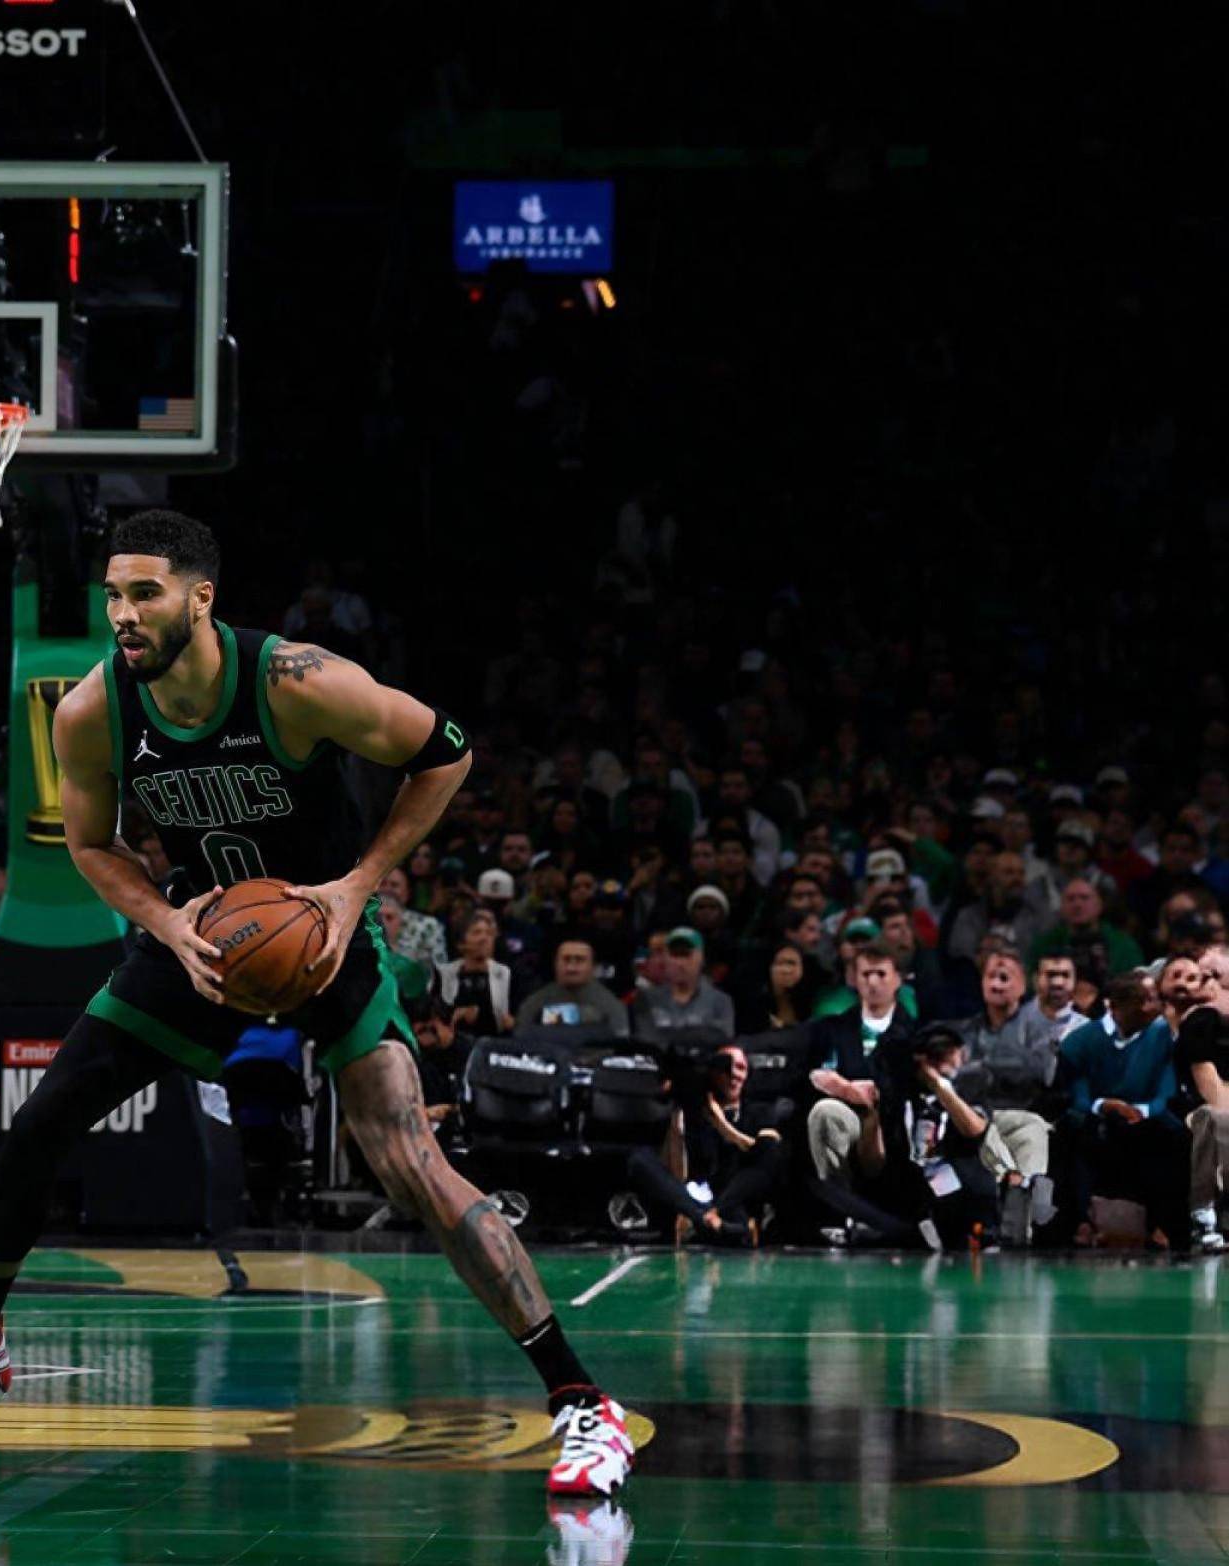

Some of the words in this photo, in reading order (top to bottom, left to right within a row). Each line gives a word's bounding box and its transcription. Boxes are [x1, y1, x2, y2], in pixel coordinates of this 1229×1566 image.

[219, 733, 262, 749] Amica
[131, 764, 294, 828] CELTICS
[88, 1079, 159, 1134] UP
